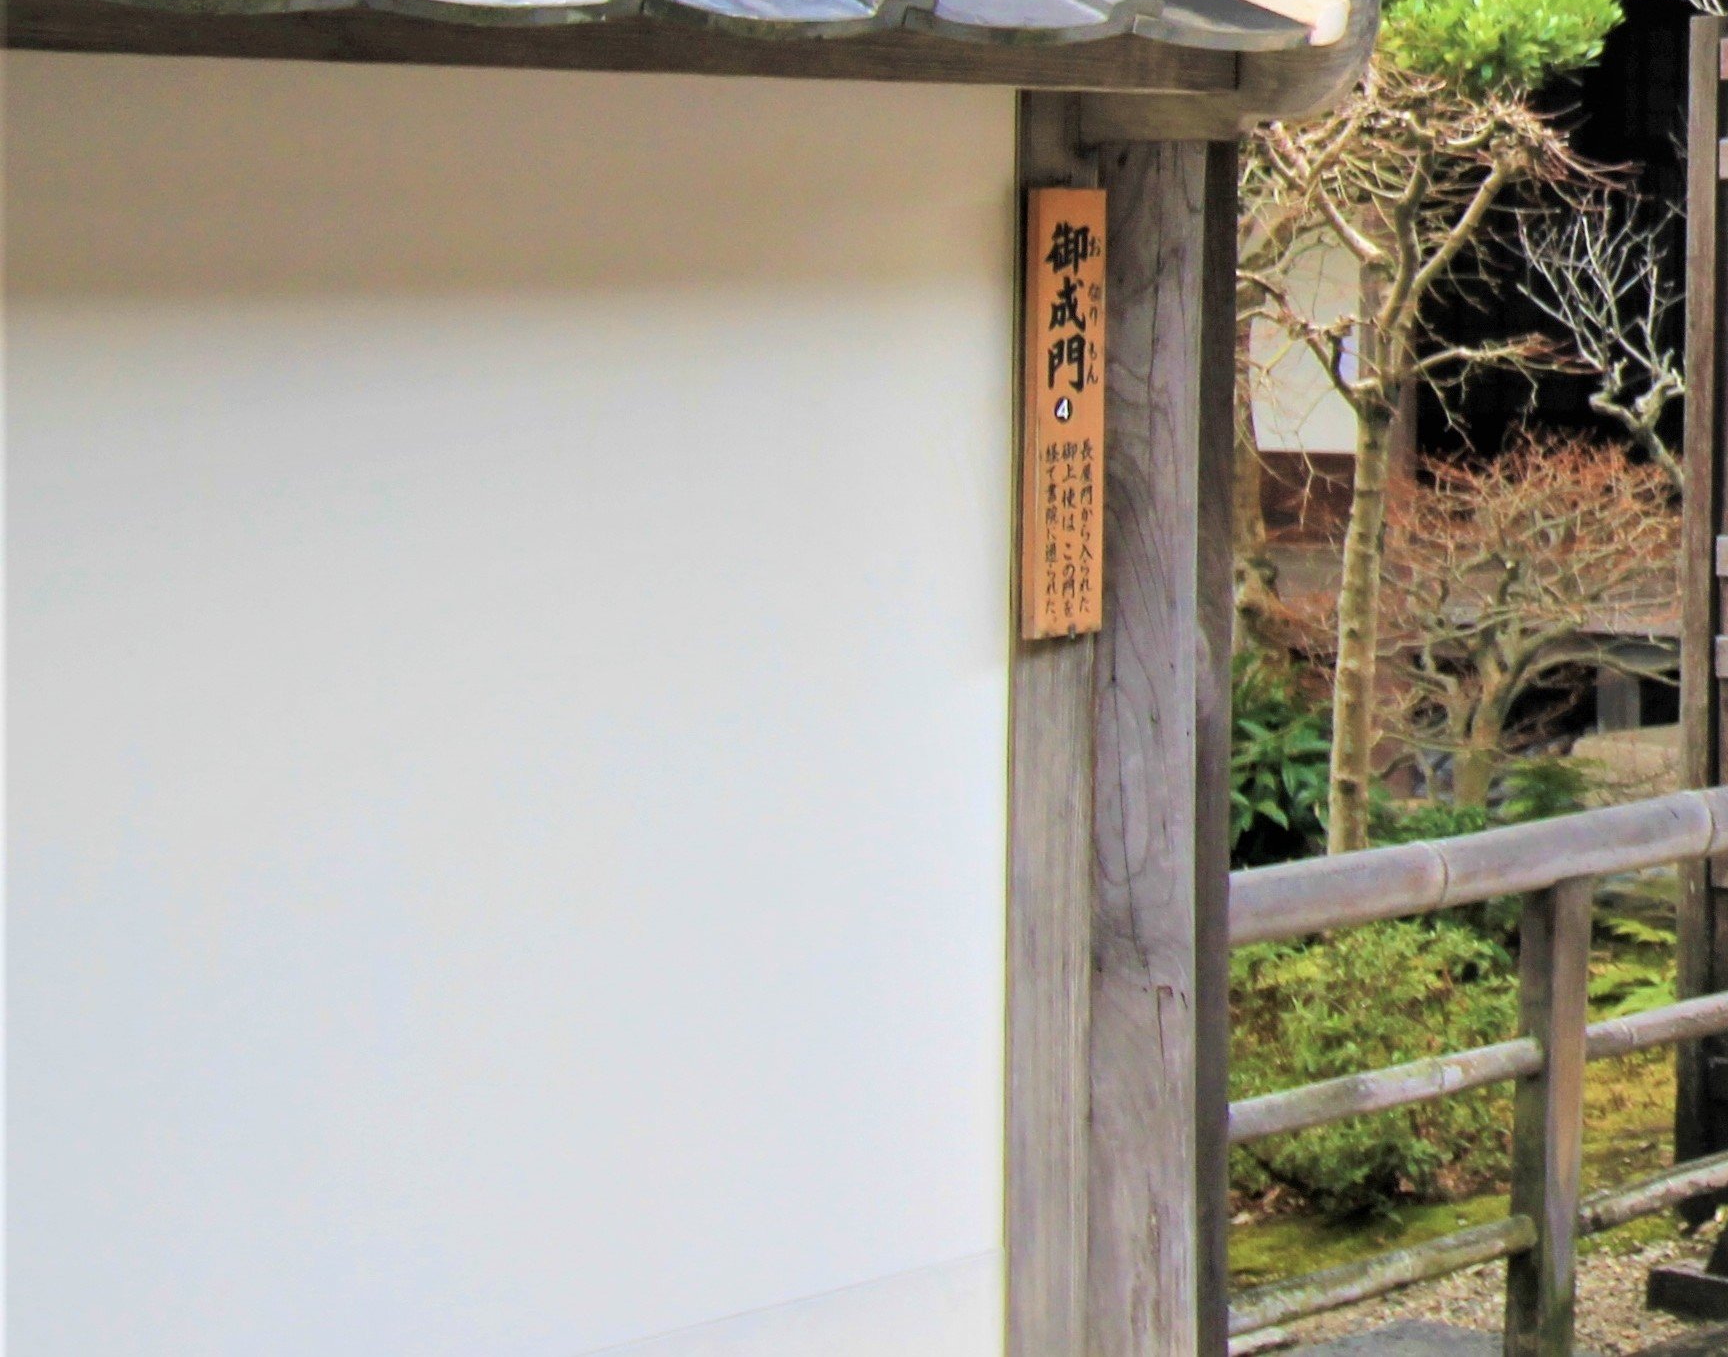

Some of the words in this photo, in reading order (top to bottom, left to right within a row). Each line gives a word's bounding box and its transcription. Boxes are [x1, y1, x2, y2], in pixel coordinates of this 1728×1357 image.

[1045, 220, 1089, 393] 御成門
[1056, 398, 1070, 420] 4
